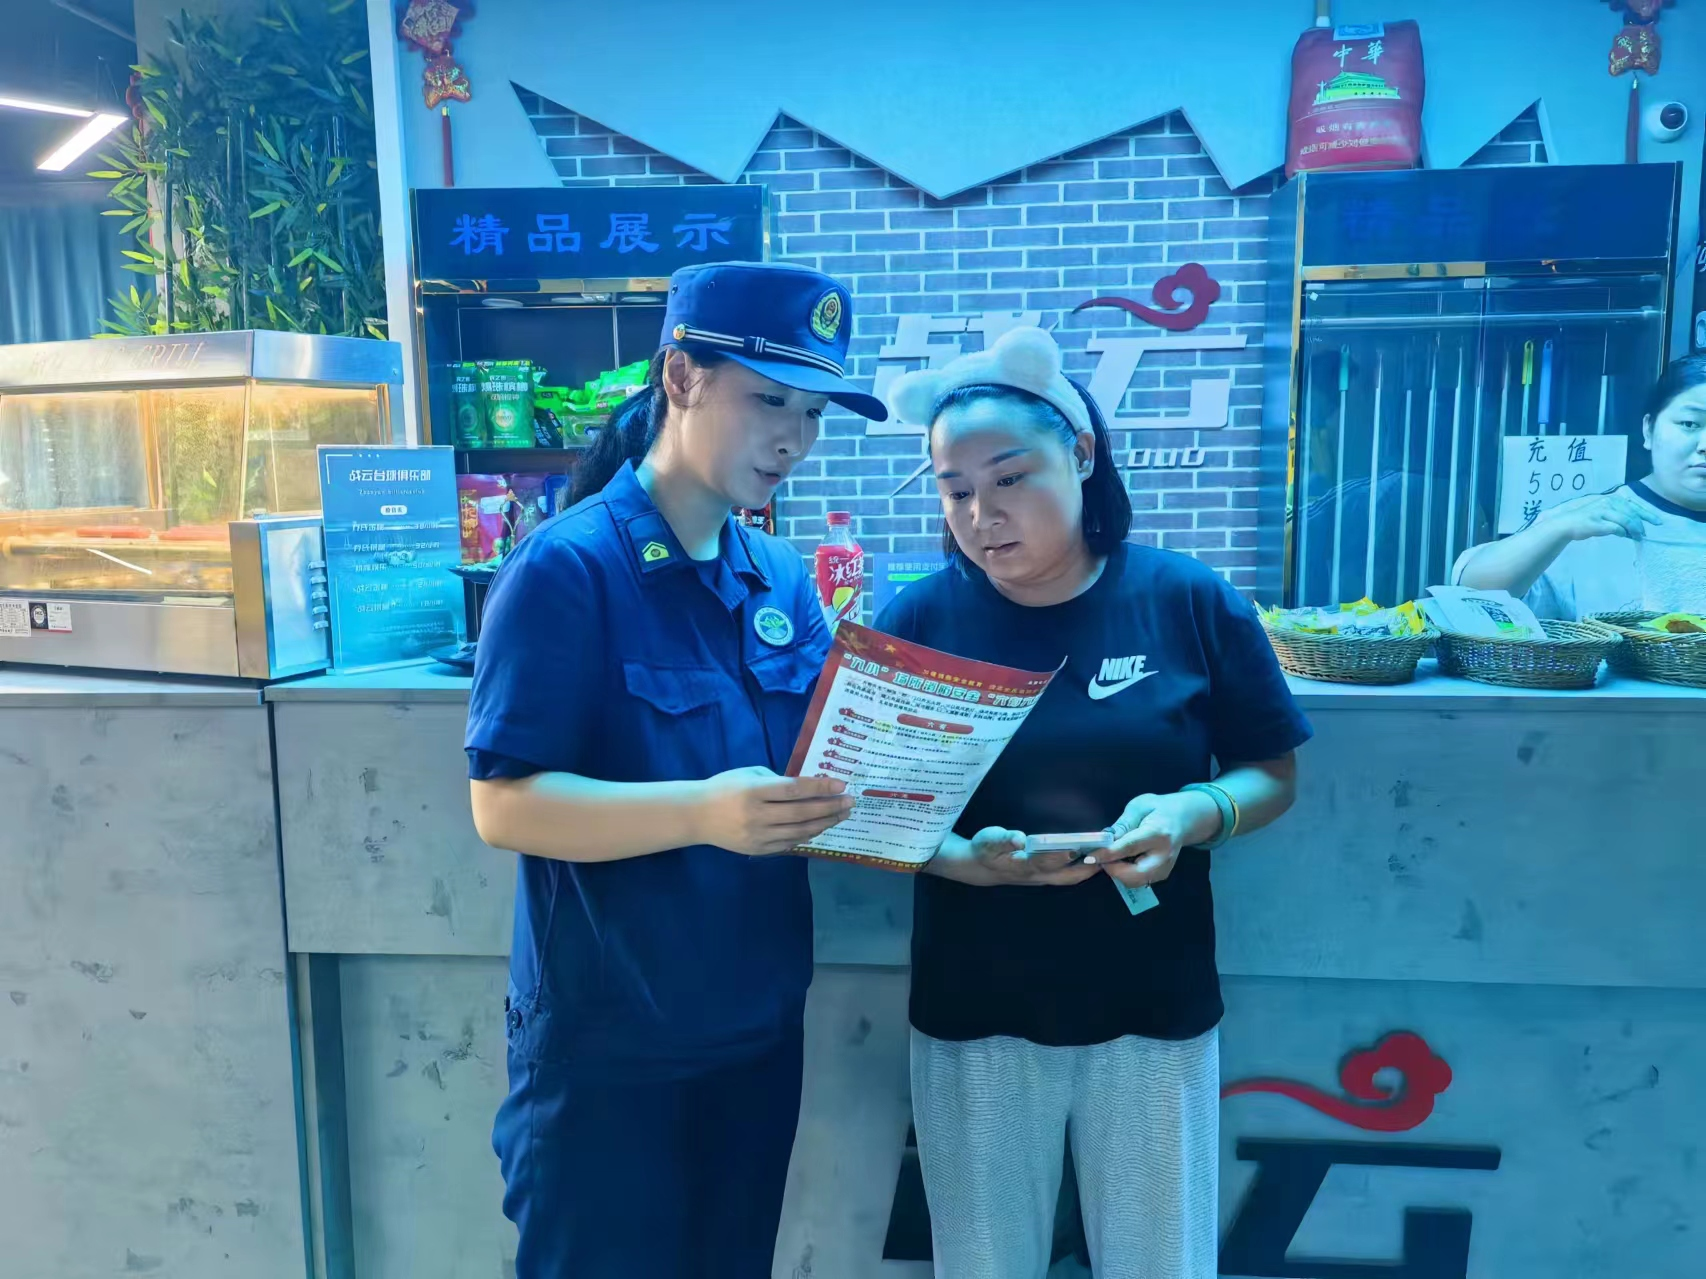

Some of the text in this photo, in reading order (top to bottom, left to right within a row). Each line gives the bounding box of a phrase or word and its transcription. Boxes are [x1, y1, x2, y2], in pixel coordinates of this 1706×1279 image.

[1332, 40, 1385, 68] 中華
[450, 213, 733, 255] 精品展示
[1527, 437, 1592, 463] 充值
[349, 469, 431, 481] 战云台球俱乐部
[1529, 472, 1586, 495] 500
[828, 556, 850, 564] 统一
[1098, 655, 1147, 681] NIKE
